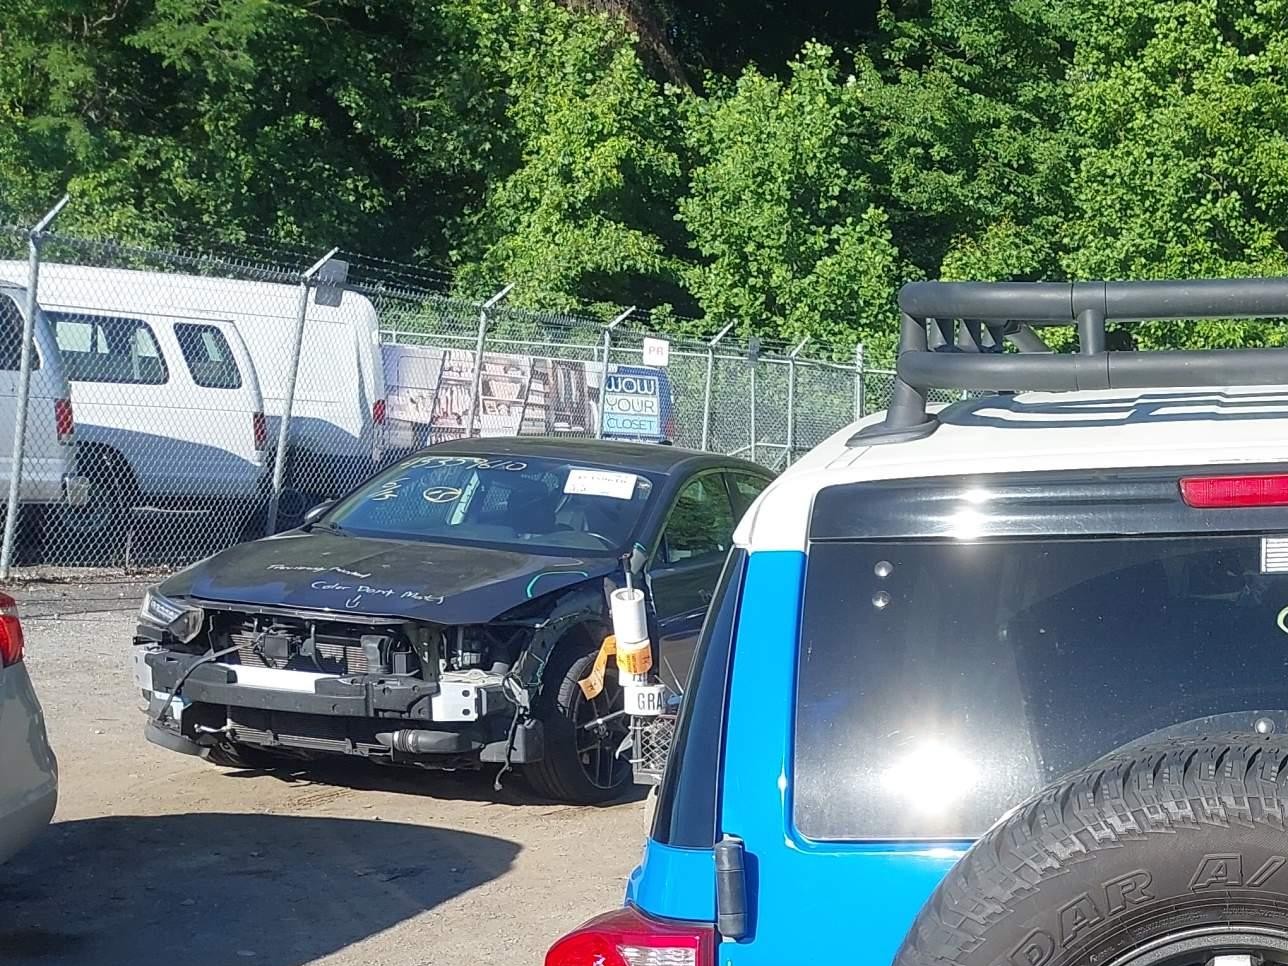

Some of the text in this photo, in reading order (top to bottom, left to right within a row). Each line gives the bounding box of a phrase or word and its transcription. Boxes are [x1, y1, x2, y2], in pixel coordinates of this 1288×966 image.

[648, 345, 664, 356] PR
[606, 377, 655, 394] WOW
[606, 397, 655, 413] YOUR
[606, 417, 656, 431] CLOSET
